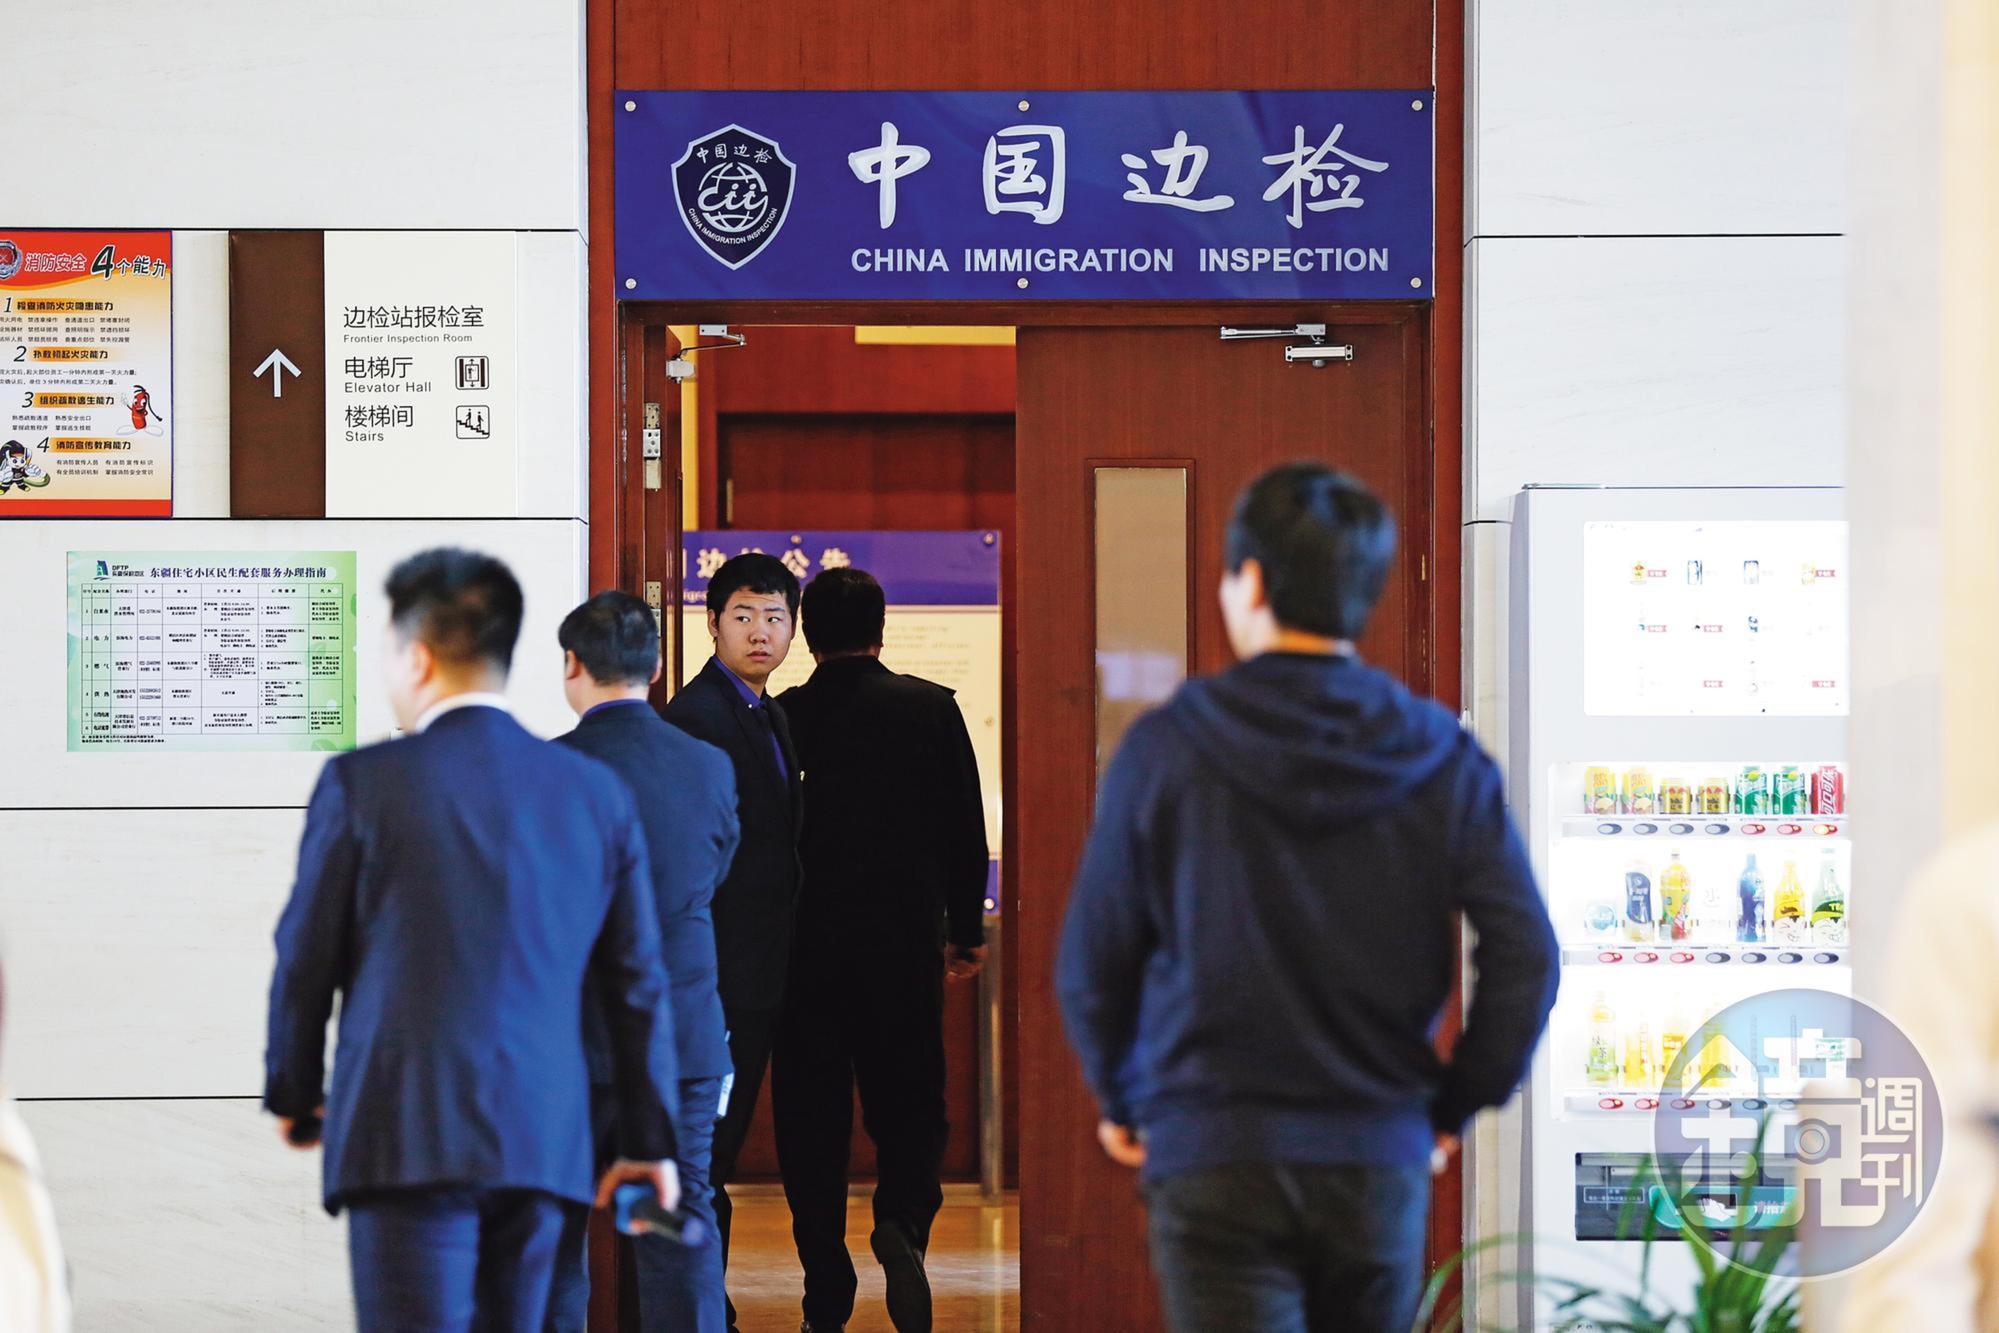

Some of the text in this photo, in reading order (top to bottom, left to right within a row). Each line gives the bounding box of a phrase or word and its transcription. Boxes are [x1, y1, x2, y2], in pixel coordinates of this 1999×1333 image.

[697, 143, 772, 164] 中国边检
[848, 121, 1389, 228] 中国边检
[688, 207, 778, 244] CHINA IMMIGRATION INSPECTION
[851, 247, 1389, 273] CHINA IMMIGRATION INSPECTION
[344, 305, 484, 328] 边检站报检室
[343, 334, 473, 344] Frontier Inspection Room
[345, 356, 413, 379] 电梯厅
[345, 382, 431, 393] Elevator Hall
[22, 391, 34, 408] 3
[345, 405, 413, 428] 楼梯间
[37, 436, 50, 453] 4
[345, 430, 384, 442] Stairs
